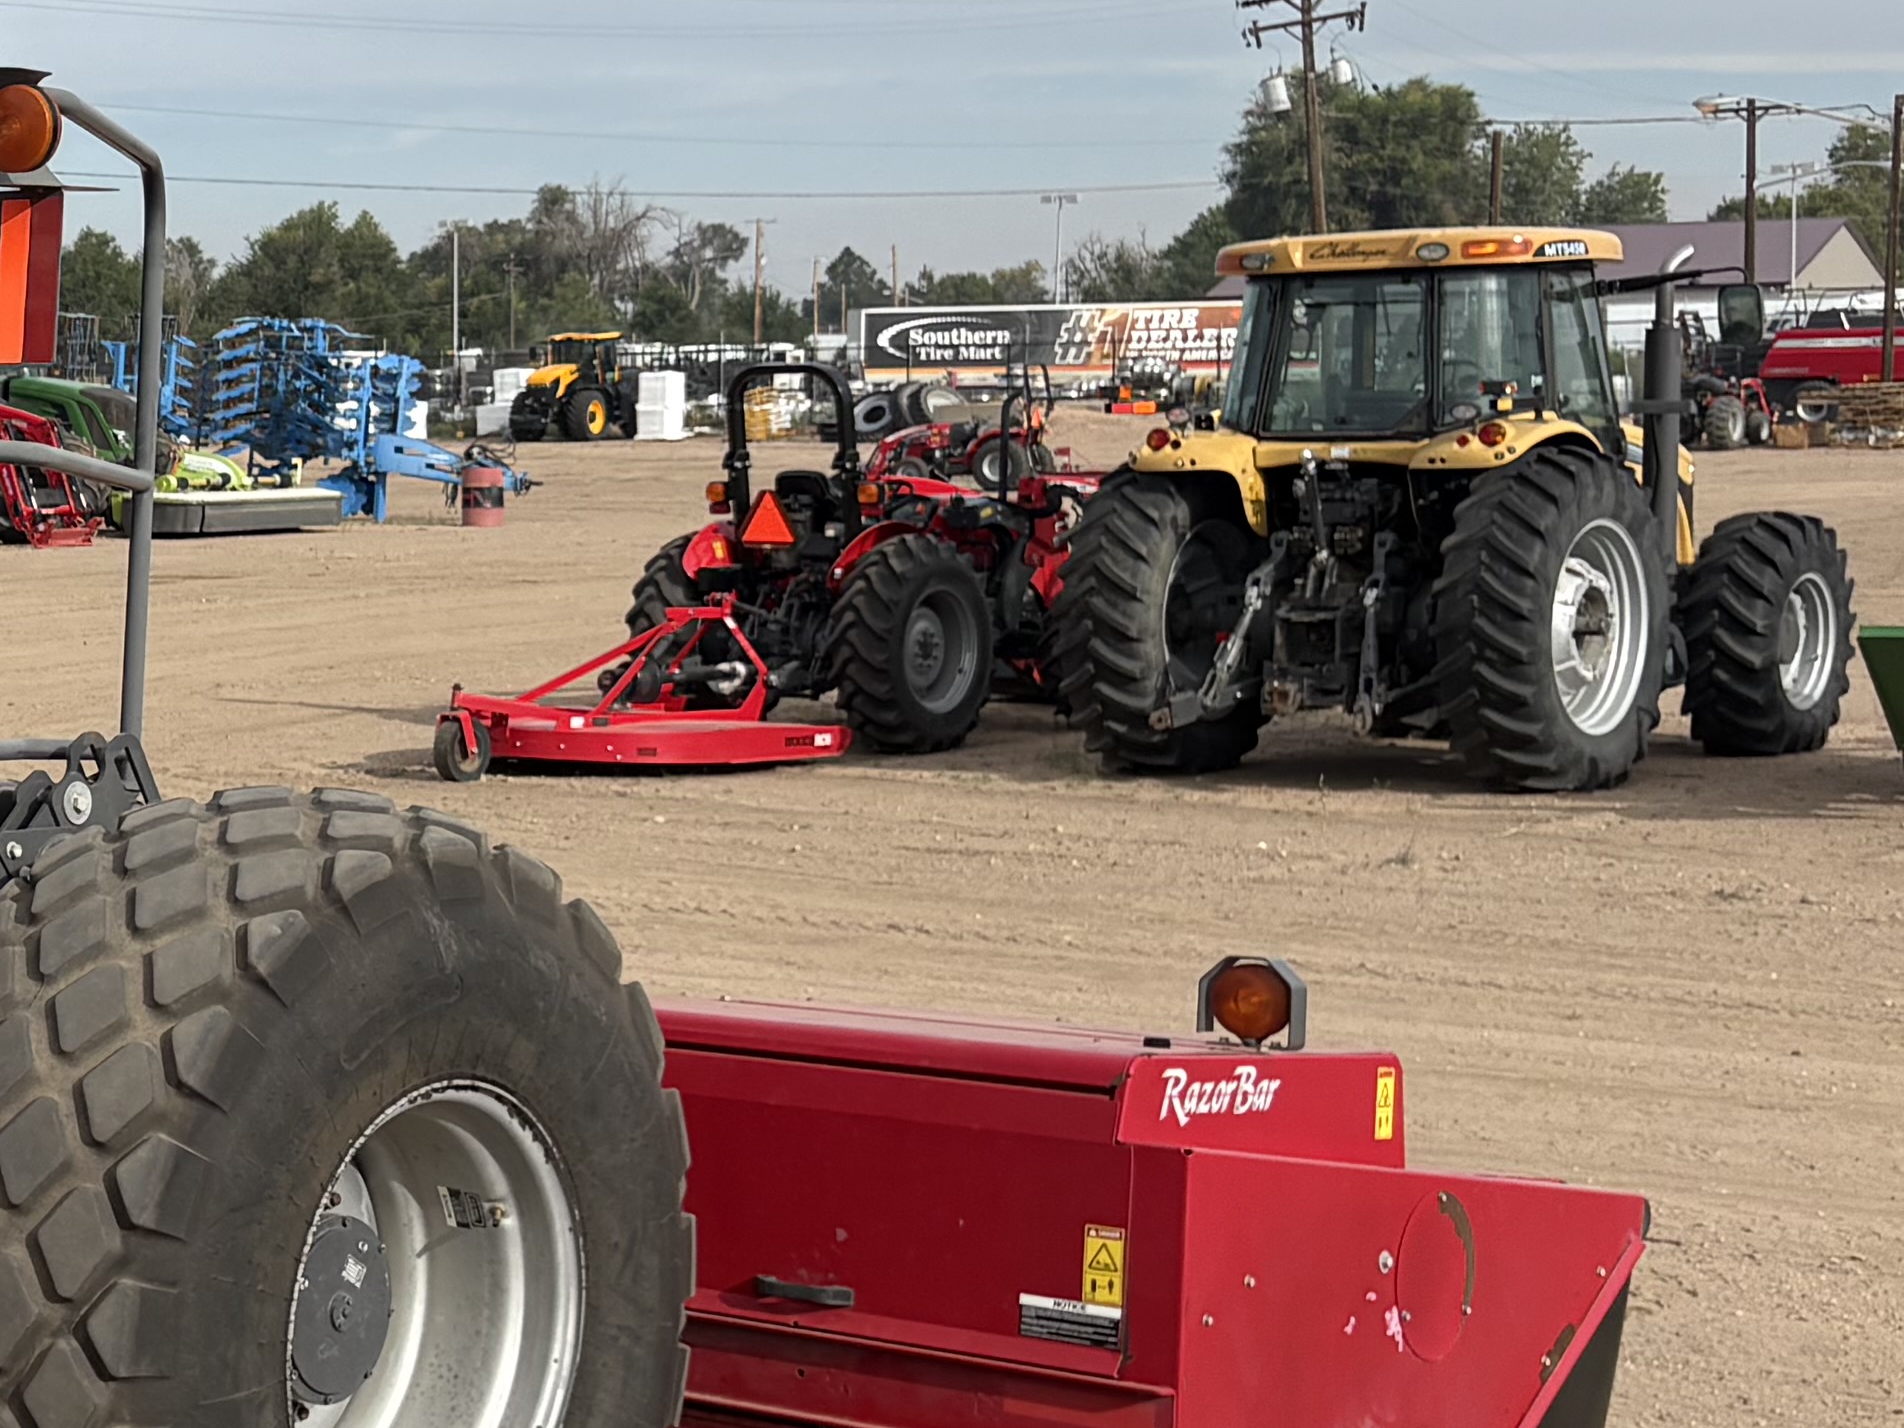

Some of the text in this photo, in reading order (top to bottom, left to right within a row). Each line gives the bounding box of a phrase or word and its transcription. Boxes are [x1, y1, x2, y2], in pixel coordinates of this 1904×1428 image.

[1133, 309, 1199, 329] TIRE
[909, 328, 1010, 345] Southern
[916, 346, 1002, 361] Tire Mart
[1159, 1065, 1281, 1127] RazorBar
